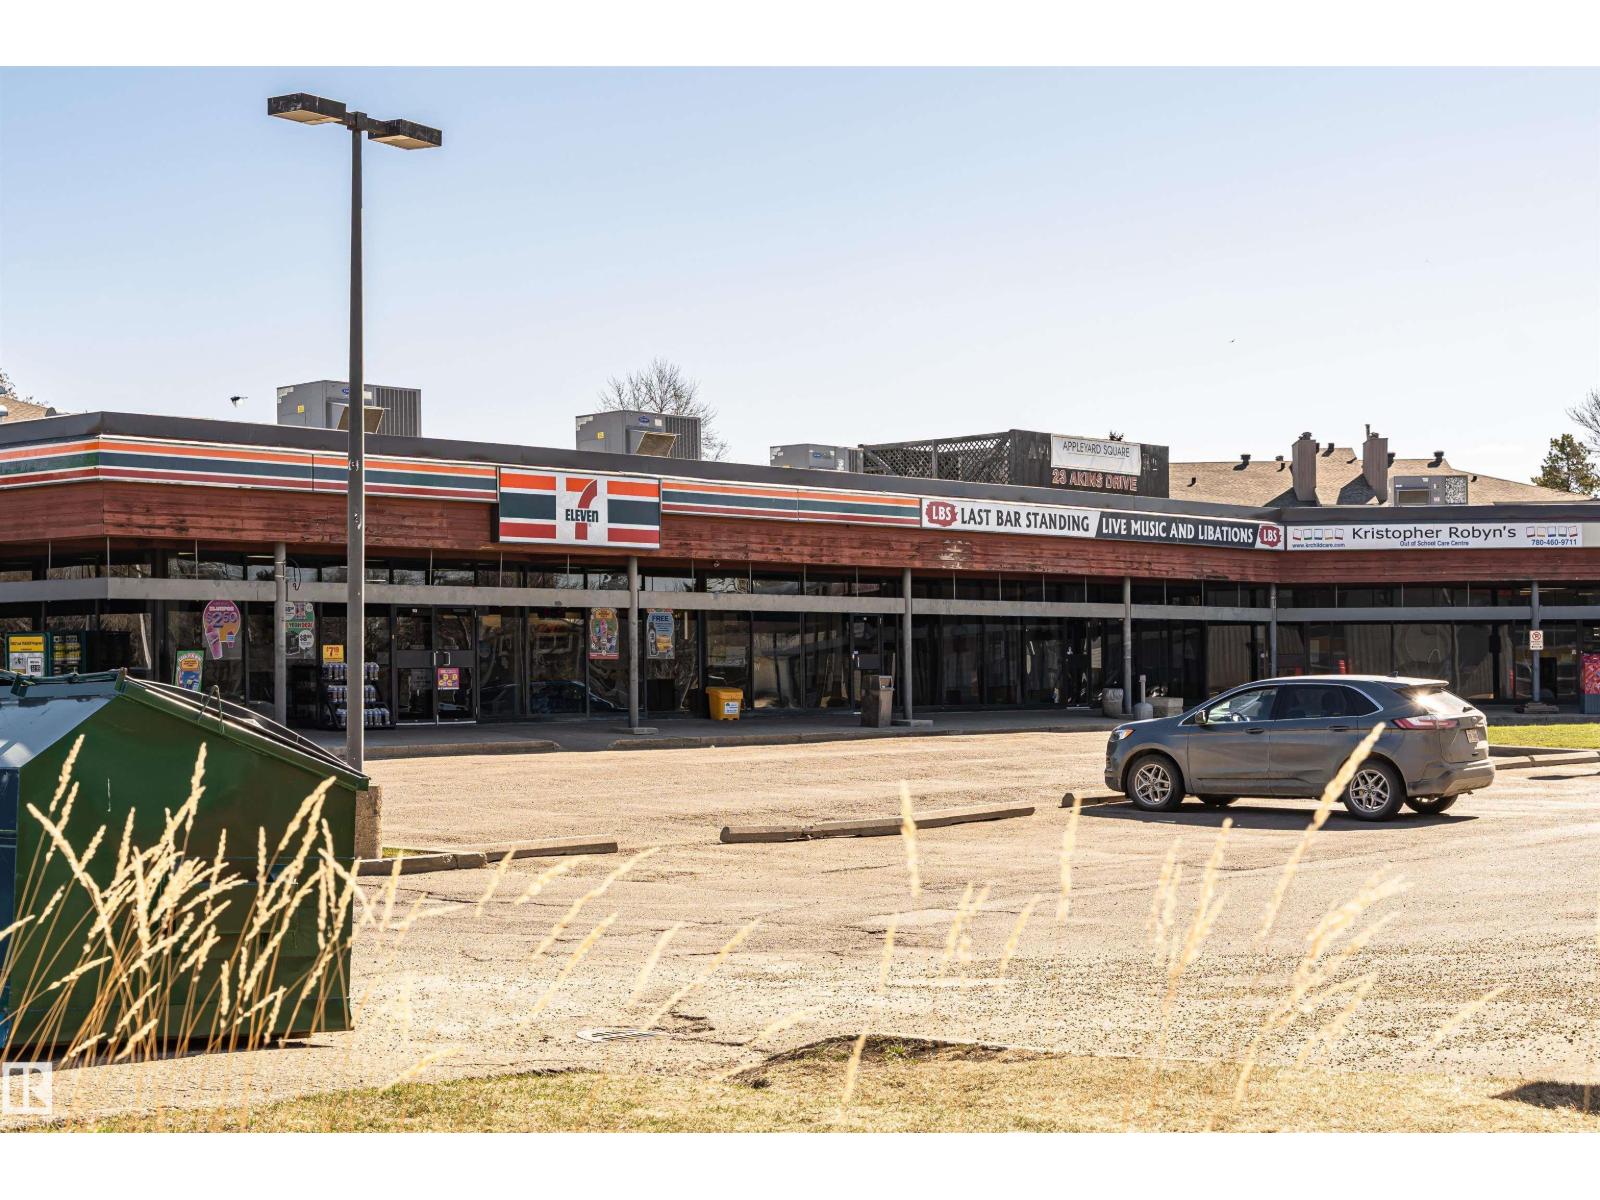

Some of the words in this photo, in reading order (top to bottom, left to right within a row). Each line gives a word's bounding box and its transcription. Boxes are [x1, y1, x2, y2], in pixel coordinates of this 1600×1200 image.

[1062, 441, 1101, 454] APPLEYARD
[1103, 445, 1130, 457] SQUARE
[1052, 468, 1067, 485] 23
[1070, 471, 1103, 488] AKINS
[1105, 474, 1138, 491] DRIVE
[932, 505, 952, 520] LBS
[961, 507, 992, 526] LAST
[996, 511, 1022, 528] BAR
[1026, 512, 1090, 532] STANDING
[1102, 518, 1127, 535] LIVE
[1131, 519, 1167, 537] MUSIC
[1169, 522, 1195, 539] AND
[1198, 525, 1253, 543] LIBATIONS
[1263, 529, 1278, 542] LBS
[1352, 526, 1442, 541] Kristopher
[1448, 526, 1517, 541] Robyn's
